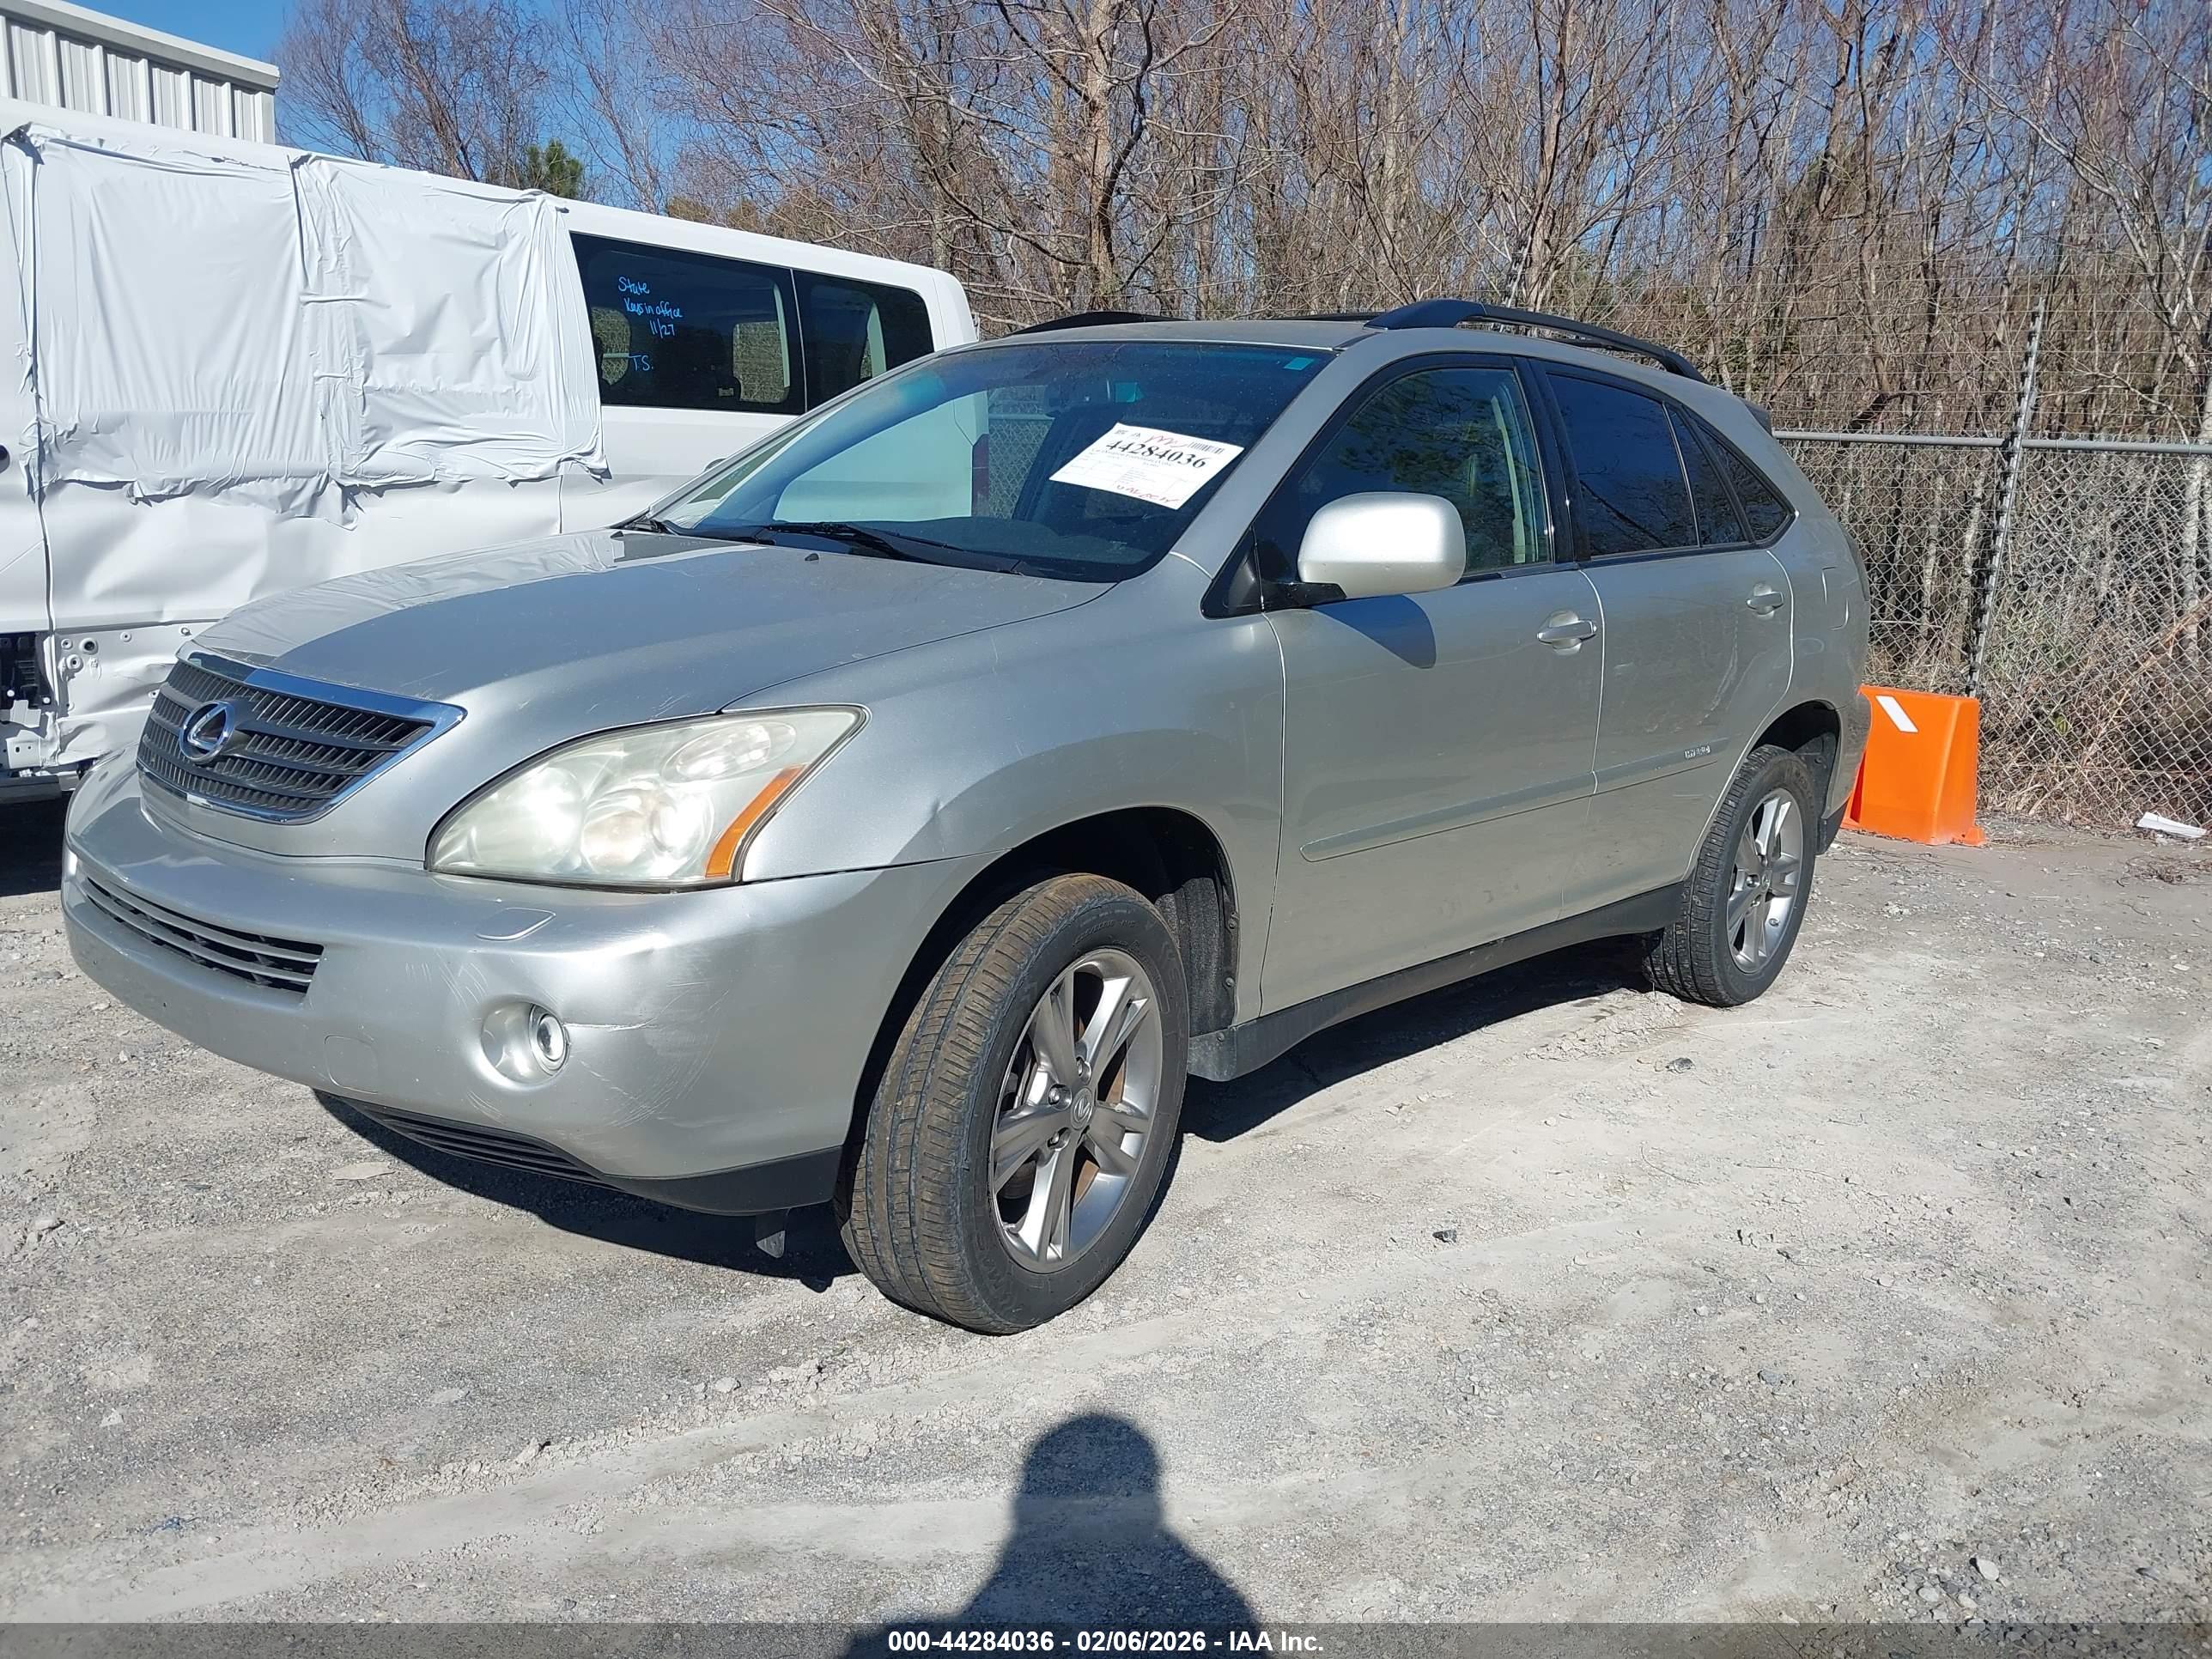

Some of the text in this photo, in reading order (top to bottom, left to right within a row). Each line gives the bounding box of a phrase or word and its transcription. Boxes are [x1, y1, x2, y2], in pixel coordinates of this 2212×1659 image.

[644, 303, 653, 315] in
[655, 301, 683, 319] office
[650, 318, 675, 338] 11/27
[1106, 440, 1210, 468] 44284036
